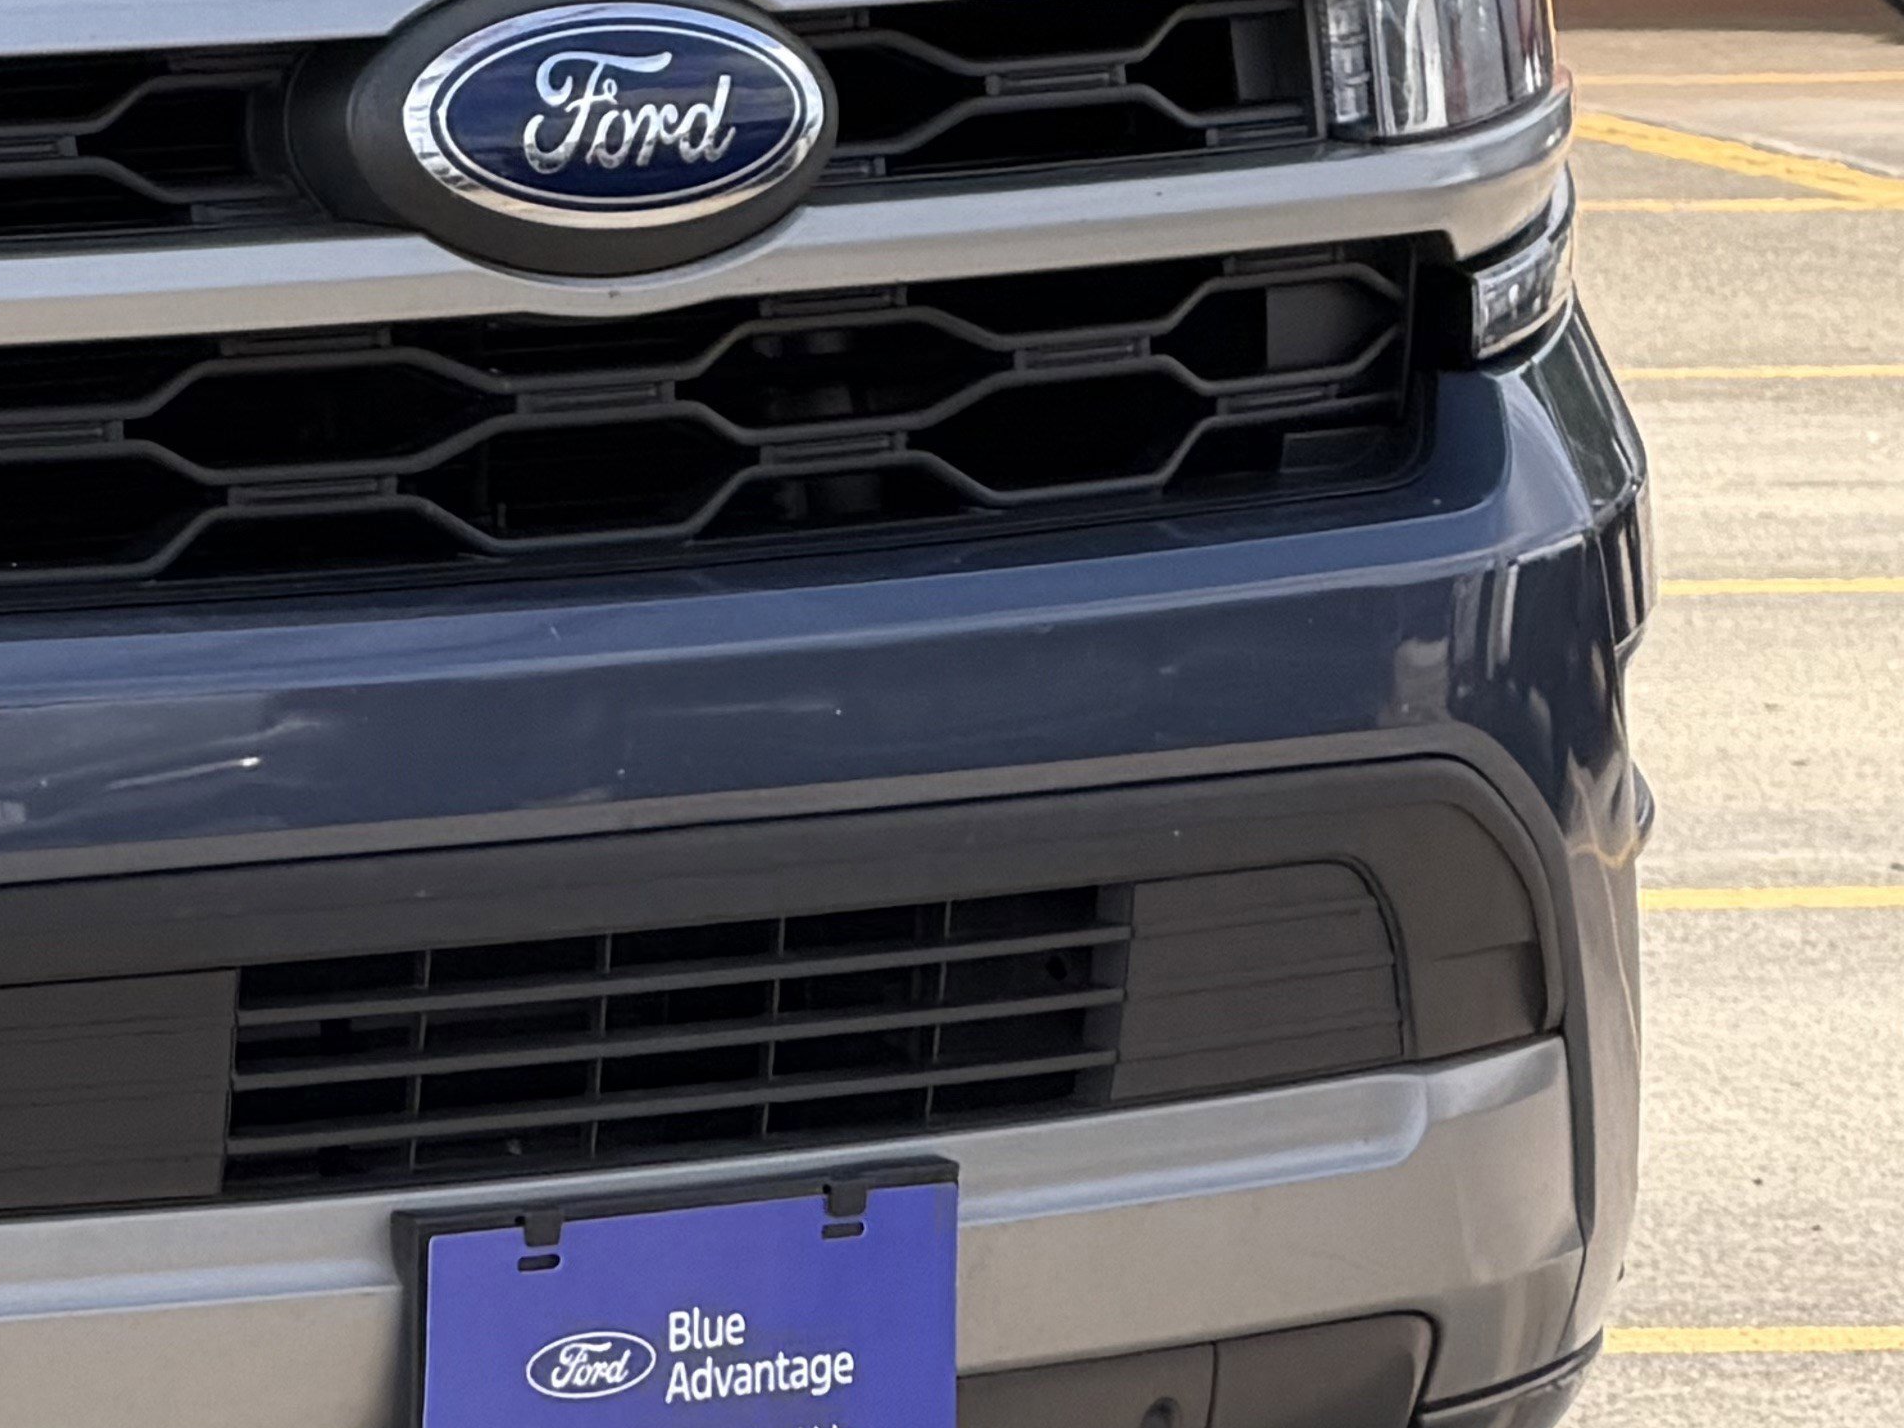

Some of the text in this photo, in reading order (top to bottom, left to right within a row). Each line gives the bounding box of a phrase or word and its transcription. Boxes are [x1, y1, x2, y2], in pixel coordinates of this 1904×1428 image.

[524, 50, 736, 175] Ford
[668, 1307, 746, 1353] Blue
[550, 1341, 630, 1390] Ford
[665, 1349, 855, 1404] Advantage
